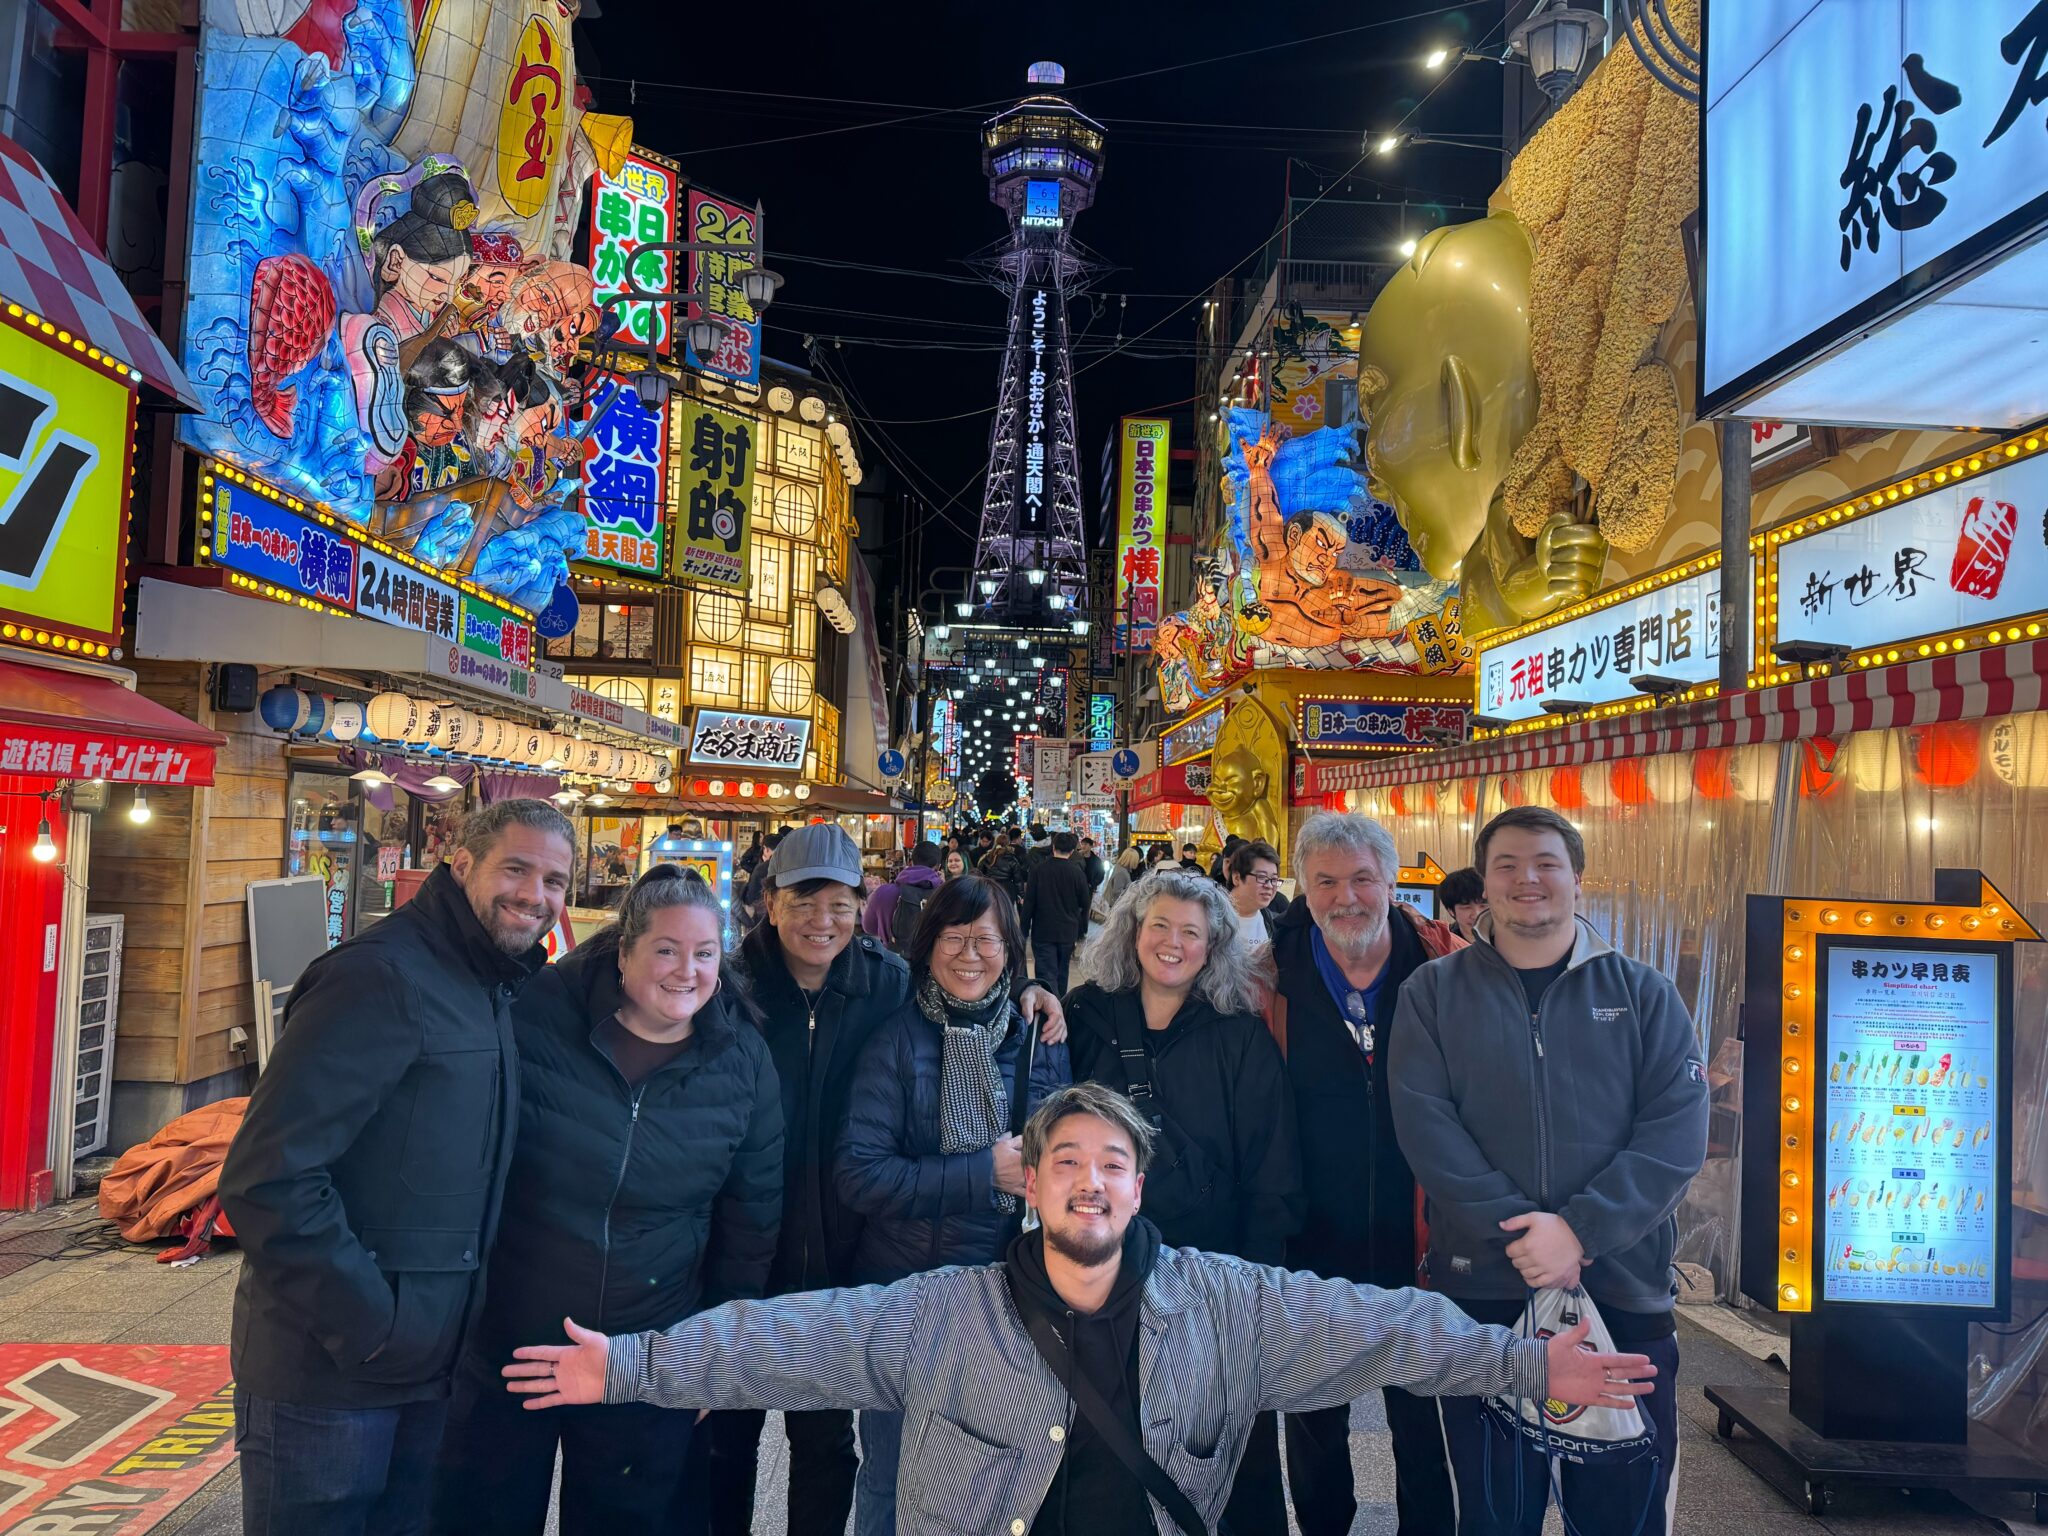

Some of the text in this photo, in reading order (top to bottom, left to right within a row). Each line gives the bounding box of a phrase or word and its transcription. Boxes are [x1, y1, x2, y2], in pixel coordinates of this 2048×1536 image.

[1035, 205, 1048, 215] 54
[1041, 188, 1048, 199] 6
[1021, 216, 1064, 227] HITACHI
[1128, 423, 1165, 439] 新世界
[588, 382, 662, 534] 横綱
[789, 444, 808, 460] 大阪
[687, 413, 751, 552] 射的
[1132, 440, 1154, 545] 日本一の串かつ
[231, 513, 299, 566] 日本一の串かつ
[585, 528, 657, 569] 通天閣店
[684, 546, 743, 569] 新世界遊技場
[299, 527, 353, 602] 横綱
[683, 559, 742, 584] チャンピオン
[360, 561, 455, 638] 24時間営業
[1121, 547, 1160, 624] 横綱
[1800, 547, 1936, 625] 新世界
[501, 617, 529, 667] 横綱
[1416, 620, 1447, 668] 横綱
[1509, 607, 1693, 702] 元祖串カツ専門店
[1307, 705, 1322, 739] 新世界
[1321, 711, 1403, 735] 日本一の串かつ
[1403, 706, 1465, 742] 横綱
[1, 738, 191, 783] 遊技場 チャンピオン
[695, 727, 802, 763] だるま商店
[1851, 959, 1970, 983] 串カツ早見表
[1883, 982, 1918, 991] Simplified
